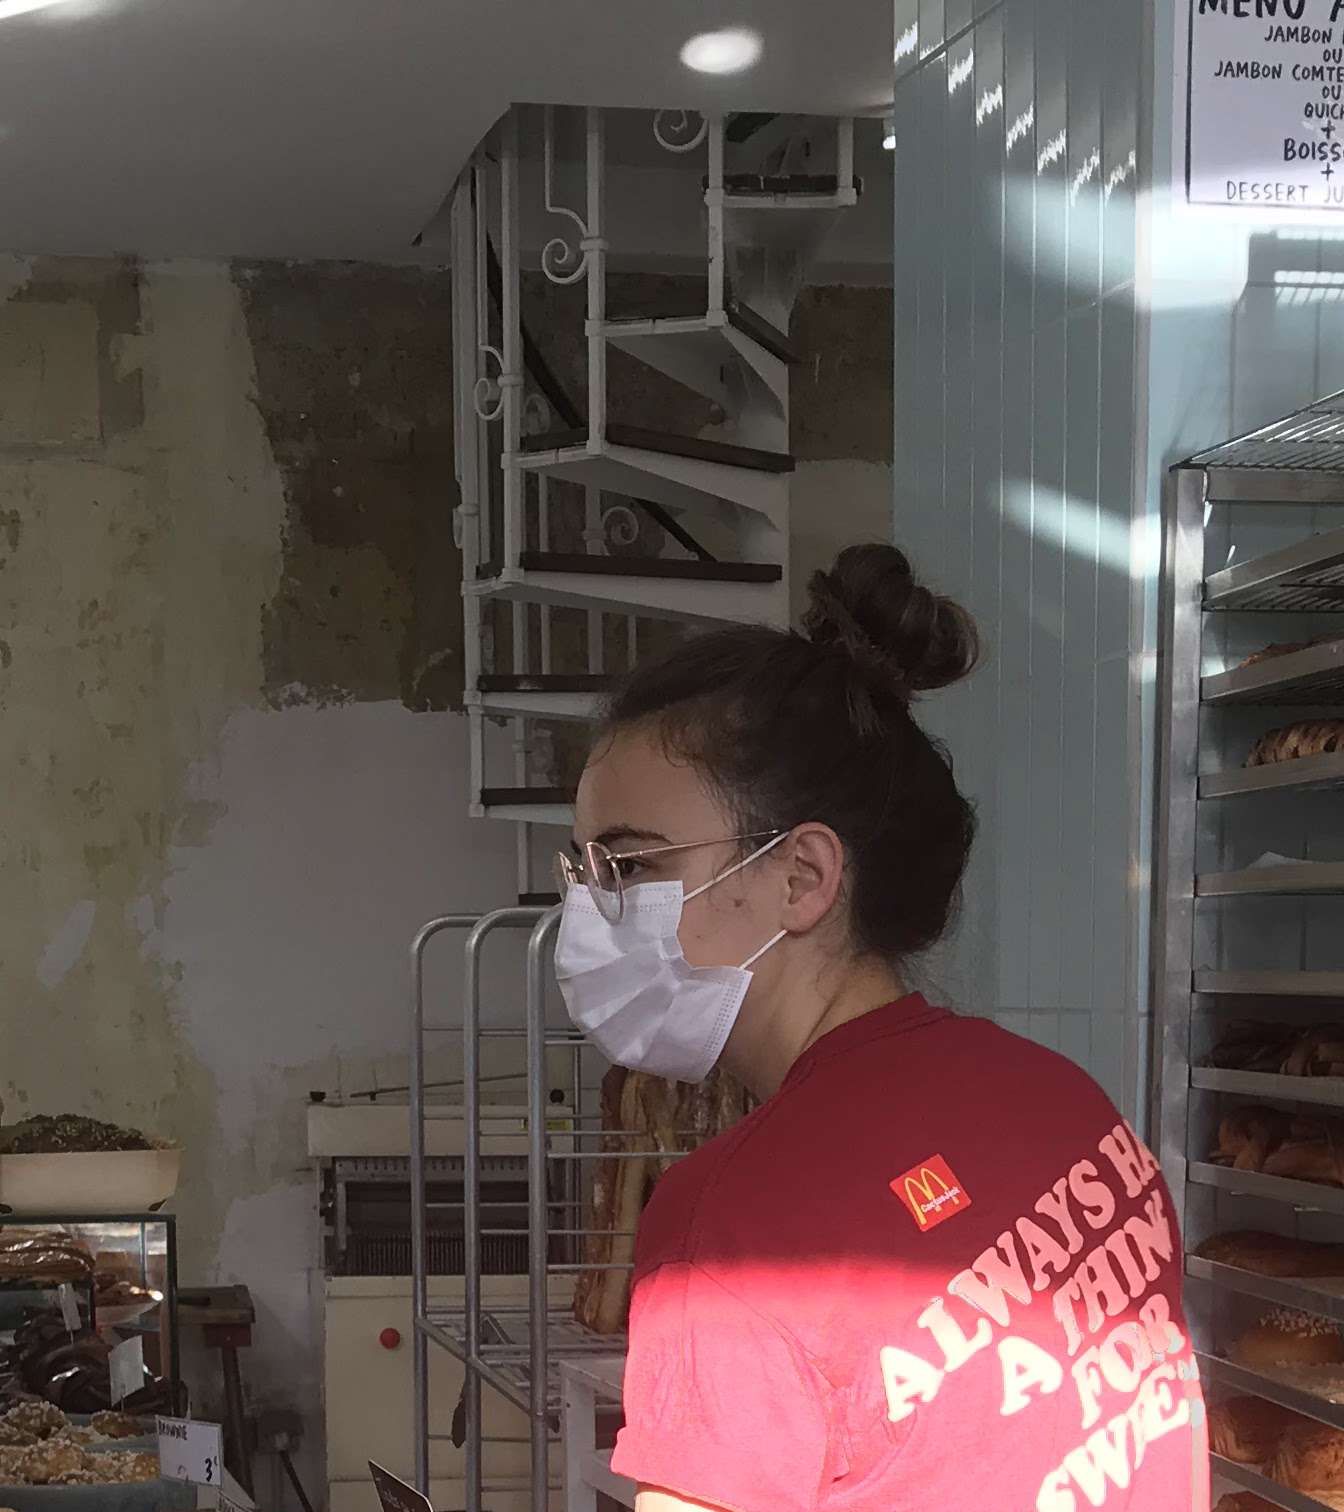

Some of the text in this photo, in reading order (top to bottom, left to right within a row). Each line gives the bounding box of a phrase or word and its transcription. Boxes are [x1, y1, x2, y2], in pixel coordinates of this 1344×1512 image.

[1264, 26, 1333, 43] JAMBON
[1323, 49, 1342, 64] OU
[1214, 61, 1282, 79] JAMBON
[1292, 63, 1344, 83] COMTE
[1322, 85, 1341, 100] OU
[1227, 180, 1309, 202] DESSERT
[880, 1156, 1115, 1422] ALWAYS
[997, 1335, 1064, 1416] A
